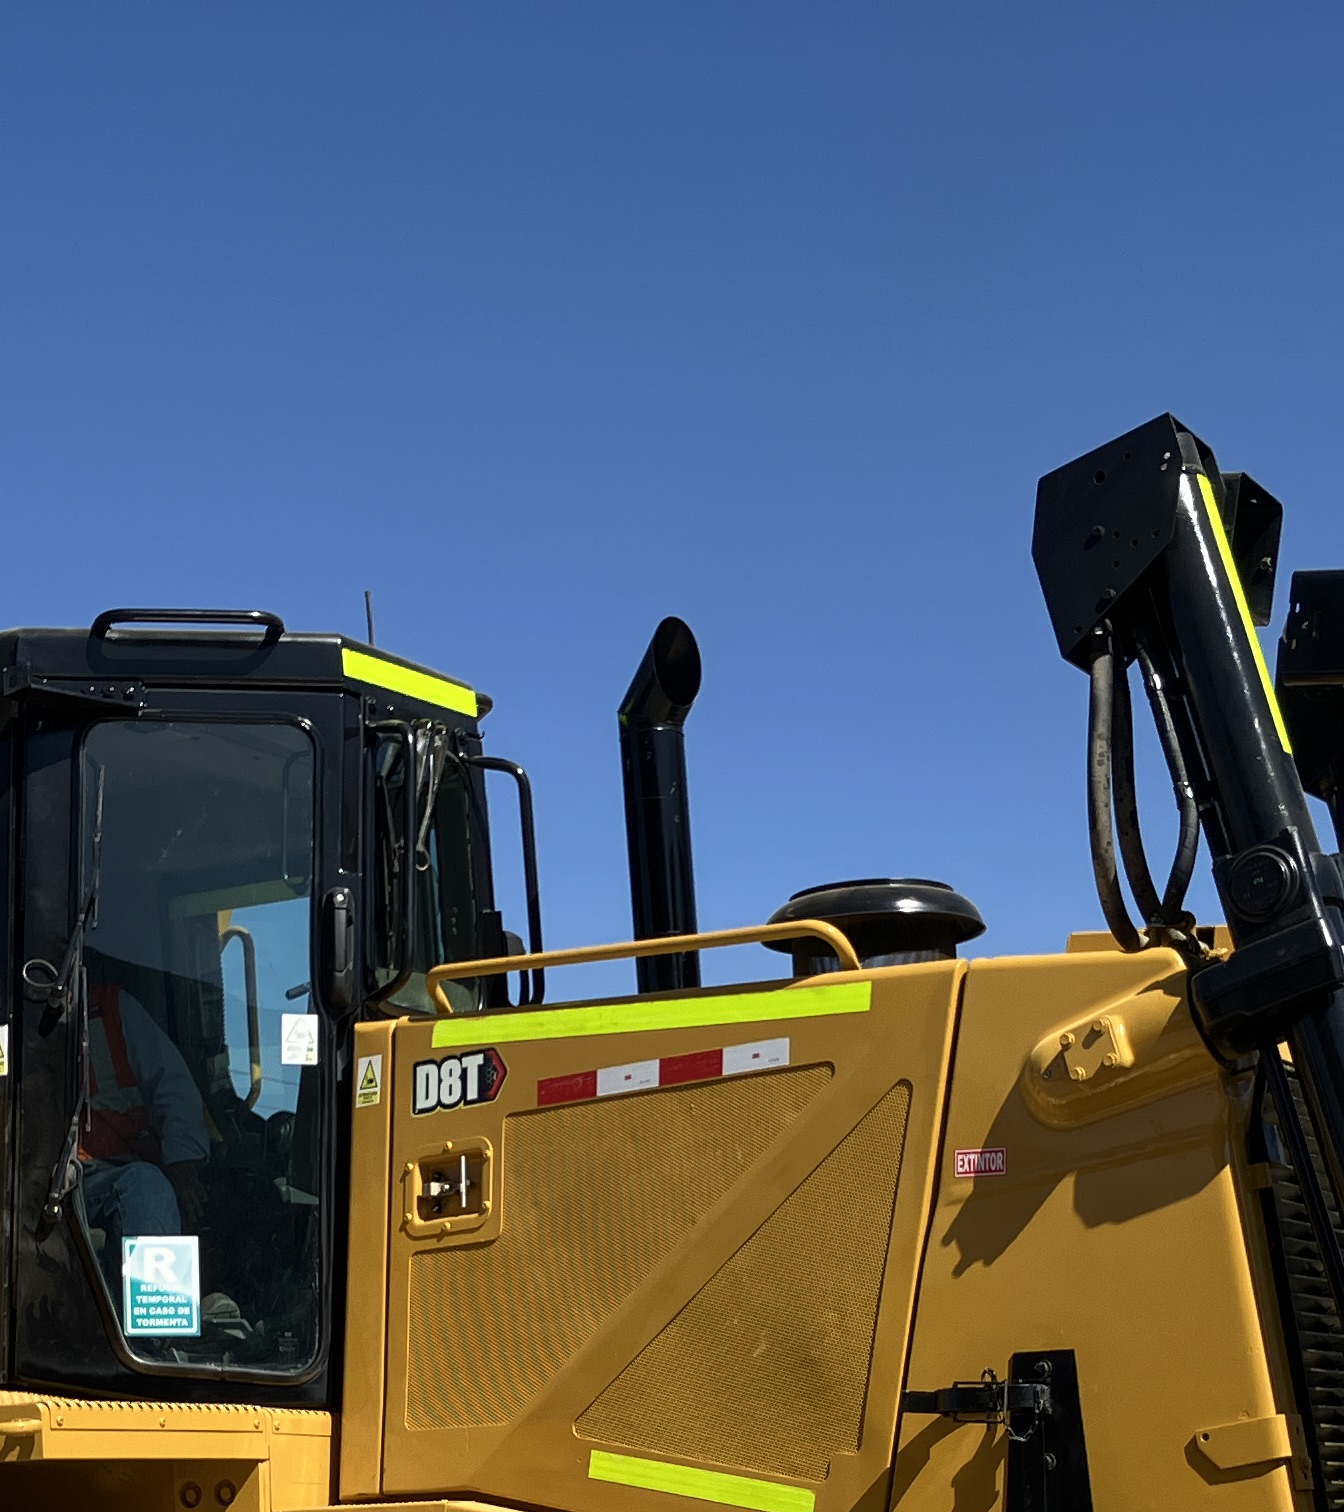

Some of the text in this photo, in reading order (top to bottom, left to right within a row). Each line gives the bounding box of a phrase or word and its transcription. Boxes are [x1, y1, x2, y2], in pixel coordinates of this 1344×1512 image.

[416, 1053, 484, 1110] D8T
[957, 1152, 1003, 1173] EXTINTOR
[142, 1246, 180, 1283] R
[136, 1295, 188, 1304] TEMPORAL
[133, 1306, 190, 1315] EN CASO DE
[136, 1317, 189, 1327] TORMENTA
